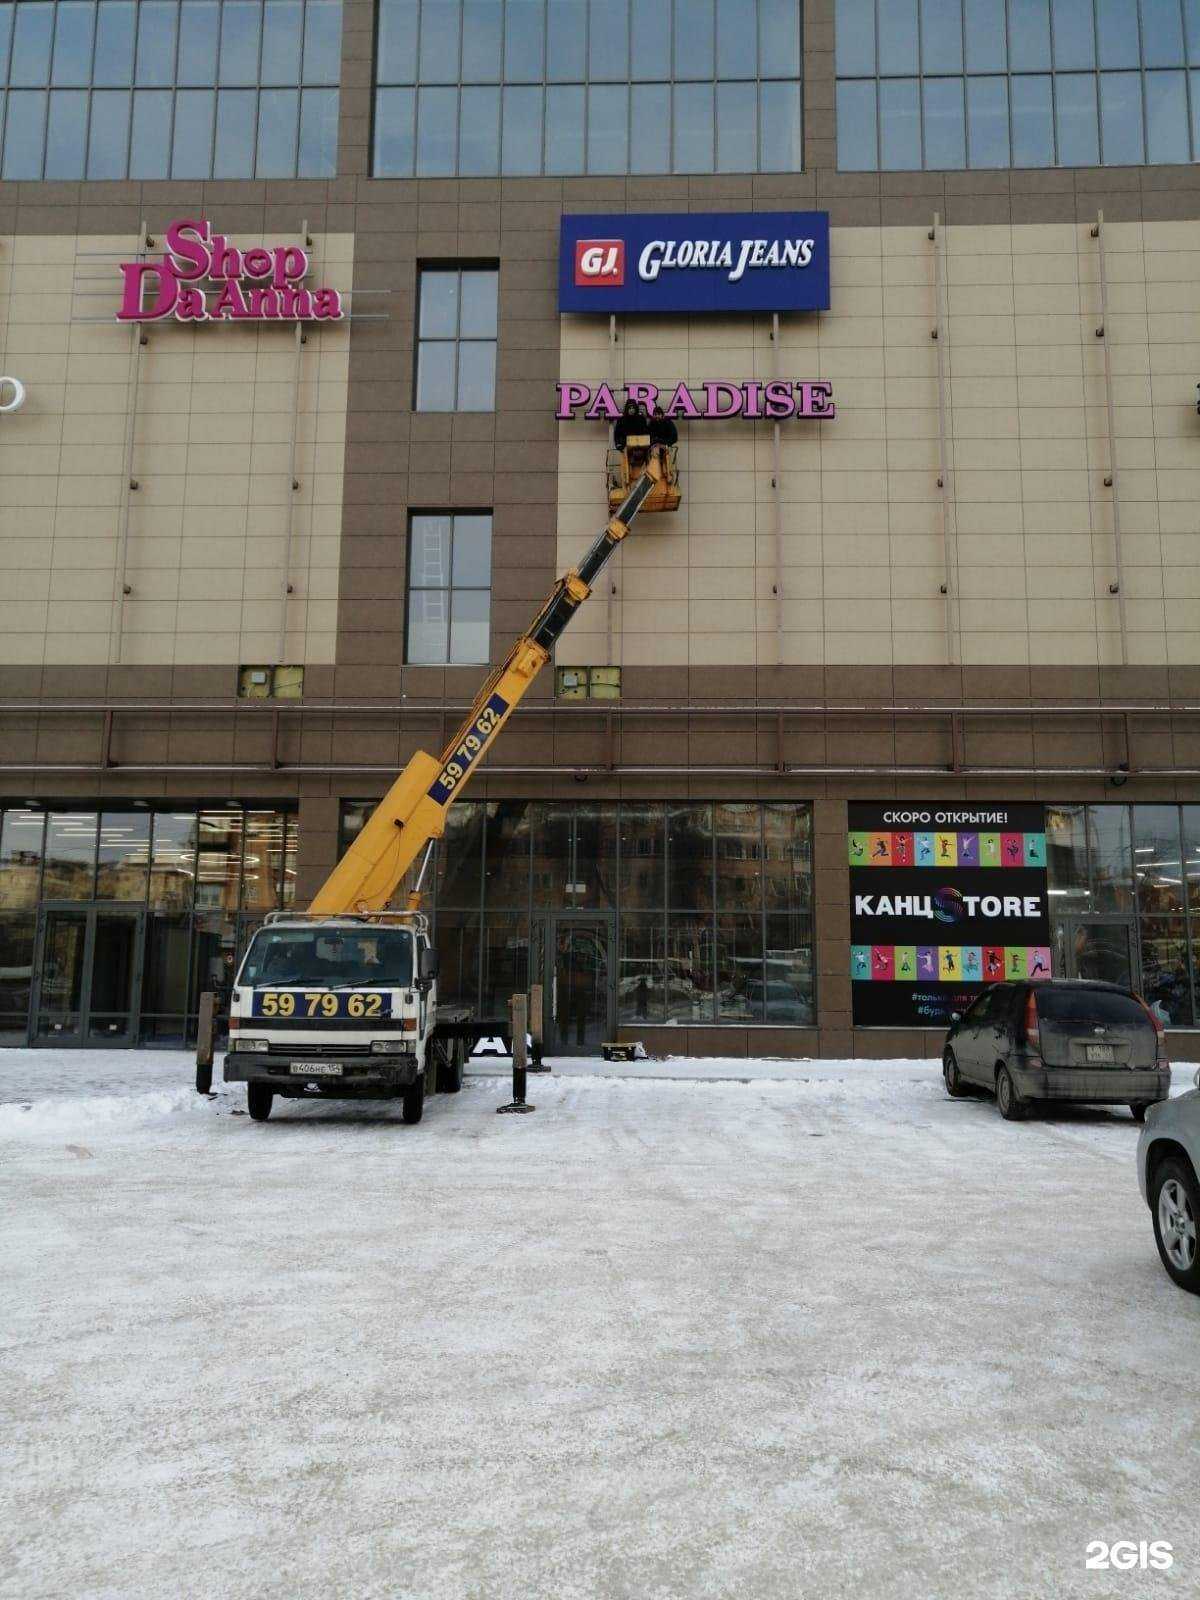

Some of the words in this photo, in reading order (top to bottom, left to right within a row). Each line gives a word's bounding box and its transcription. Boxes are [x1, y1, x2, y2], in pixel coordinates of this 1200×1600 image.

[166, 218, 308, 290] Shop
[638, 240, 734, 282] GLORIA
[728, 239, 815, 282] JEANS
[555, 381, 836, 420] PARADISE
[439, 762, 463, 790] 59
[456, 734, 481, 762] 79
[476, 707, 501, 735] 62
[883, 811, 931, 824] СКОРО
[934, 811, 1009, 824] ОТКРЫТИЕ!
[261, 993, 296, 1017] 59
[304, 993, 339, 1018] 79
[347, 993, 383, 1018] 62
